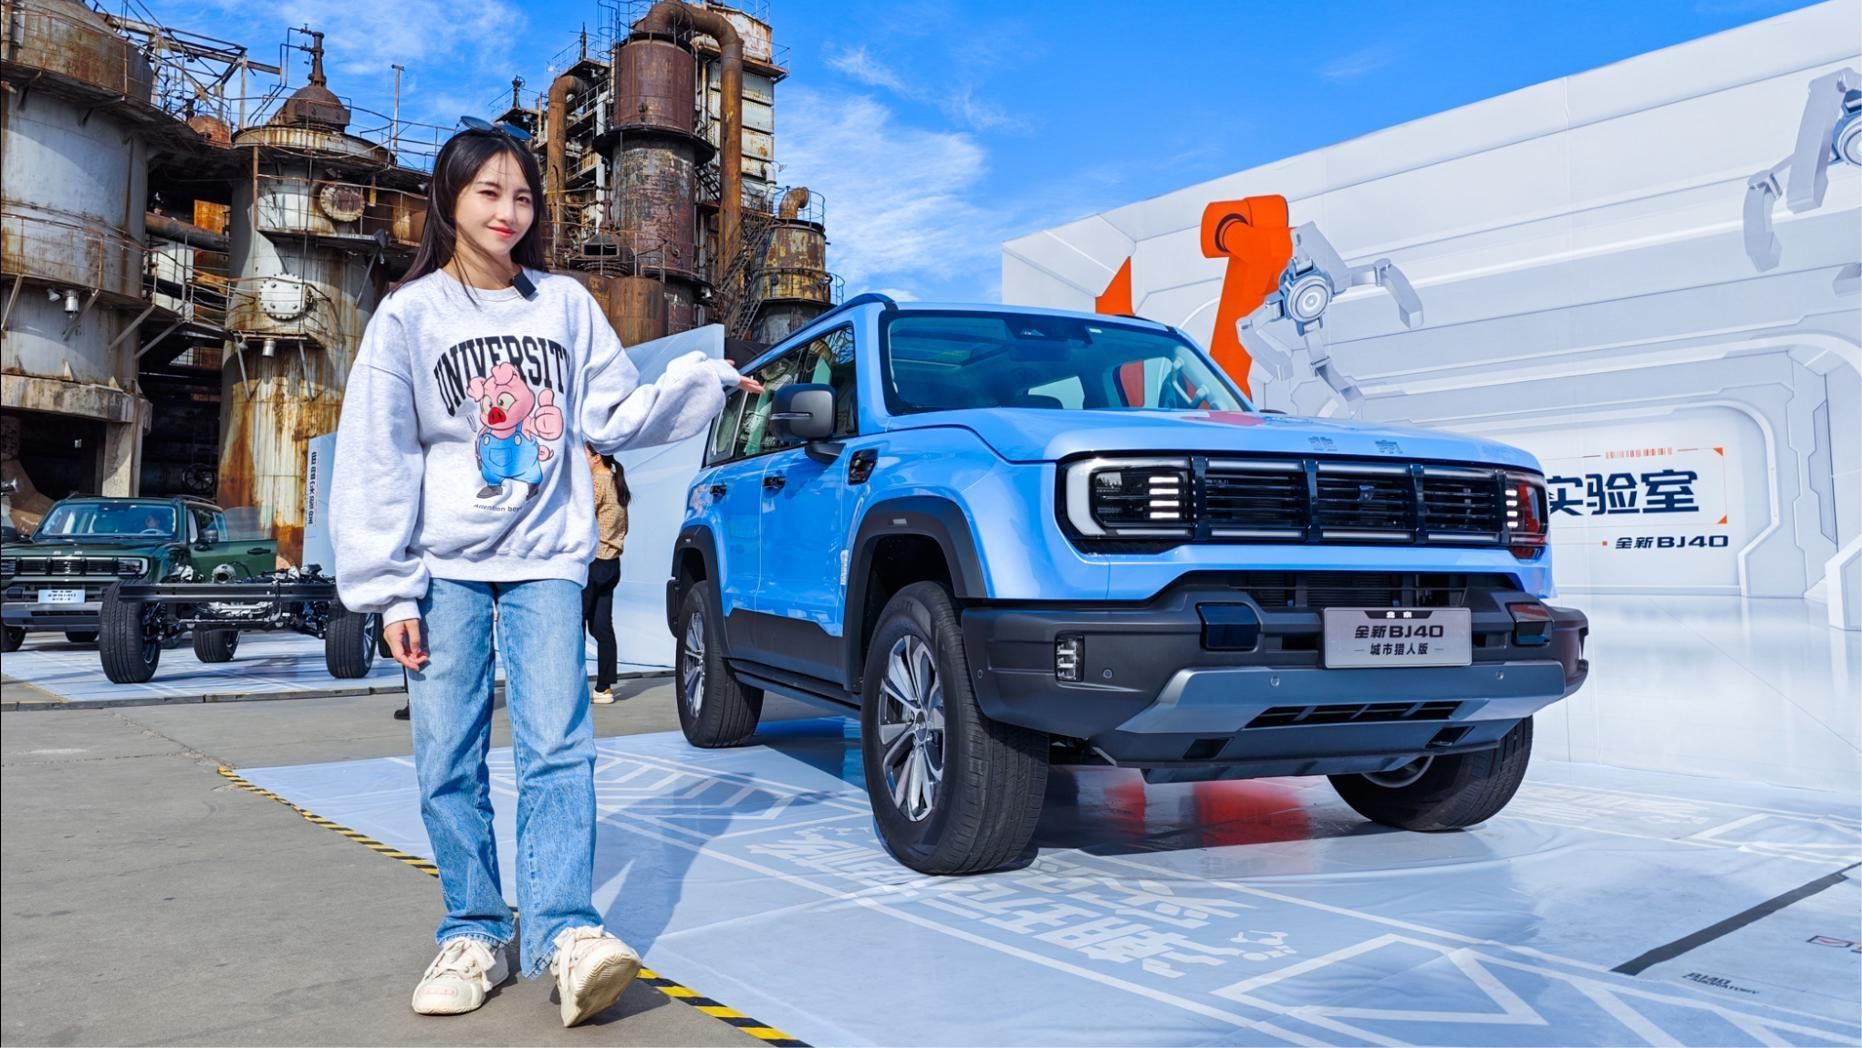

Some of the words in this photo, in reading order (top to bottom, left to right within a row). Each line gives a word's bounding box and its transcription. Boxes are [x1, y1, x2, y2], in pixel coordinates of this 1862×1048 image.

[1545, 469, 1700, 516] 实验室
[1615, 535, 1729, 549] 全新BJ40
[1355, 625, 1444, 639] 全新BJ40
[1370, 643, 1428, 655] 城市猎人版
